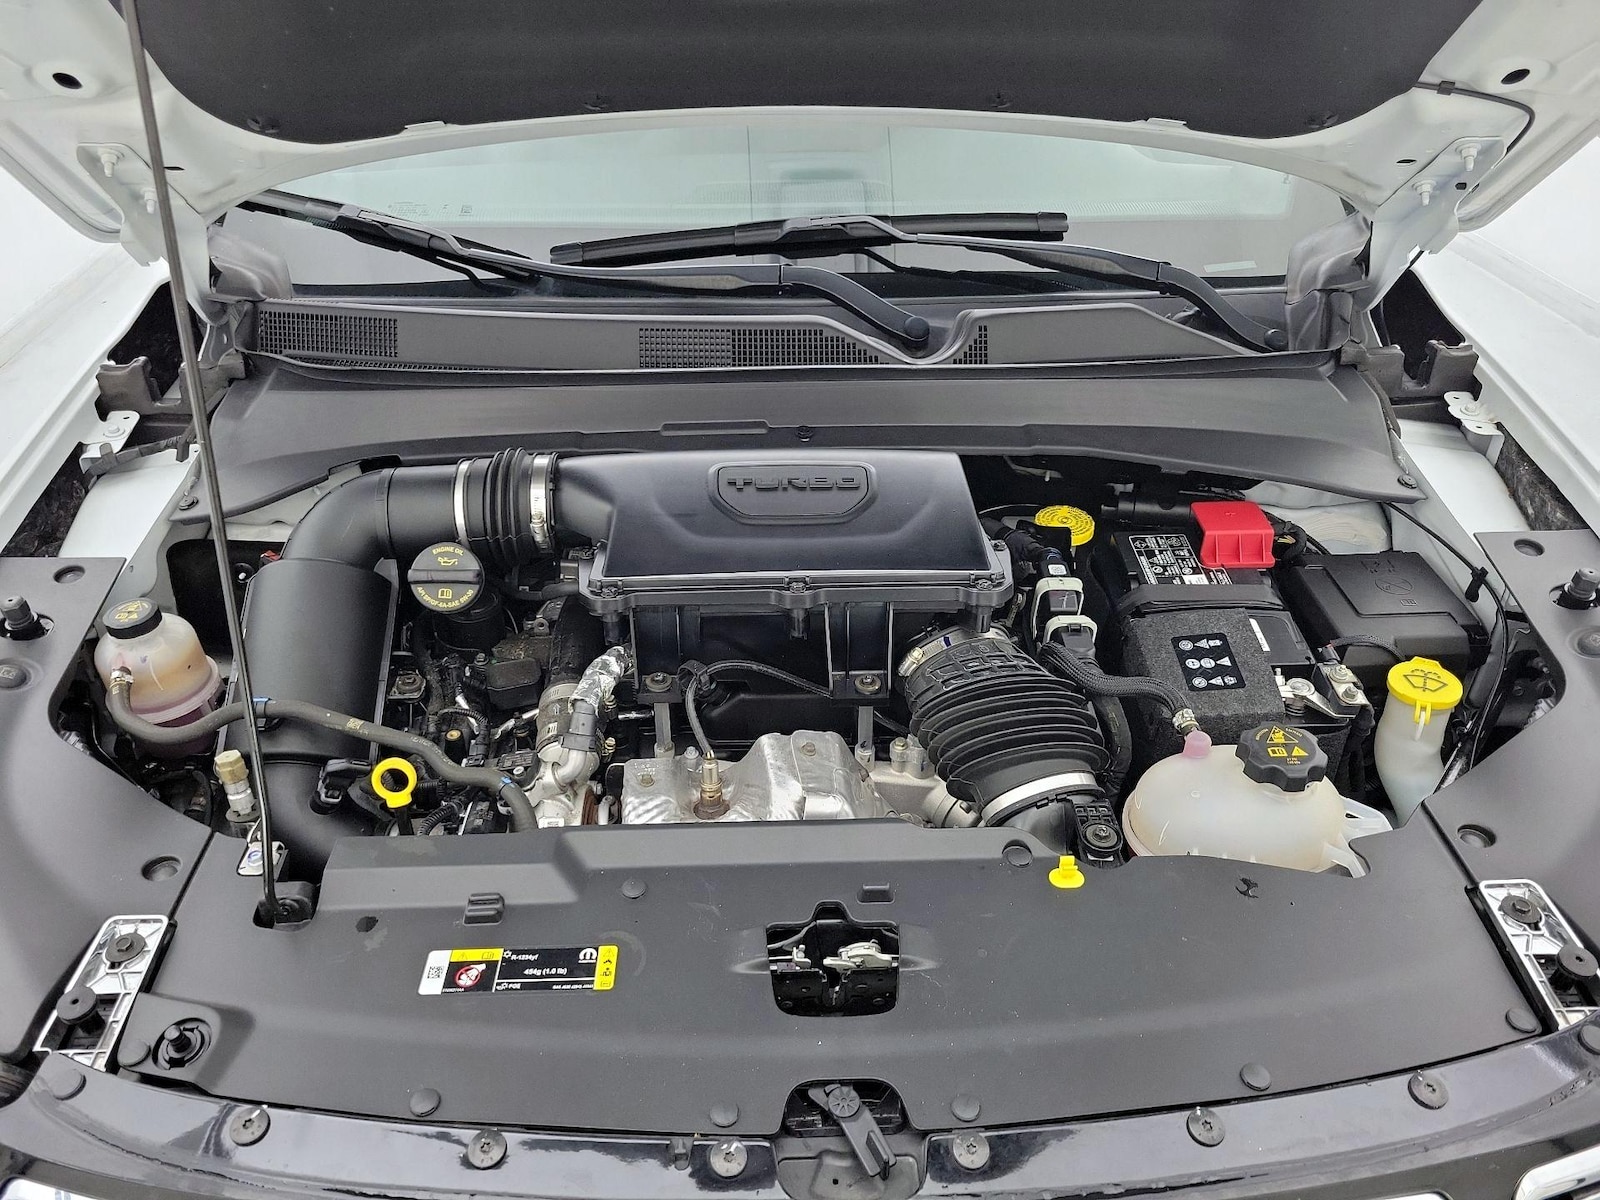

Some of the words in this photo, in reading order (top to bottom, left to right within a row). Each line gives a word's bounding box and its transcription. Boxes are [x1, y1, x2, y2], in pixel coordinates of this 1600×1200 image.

[727, 477, 861, 491] TURBO
[432, 547, 454, 555] ENGINE
[454, 547, 464, 556] OIL
[511, 953, 539, 962] R-1234yf
[523, 968, 542, 976] 454g
